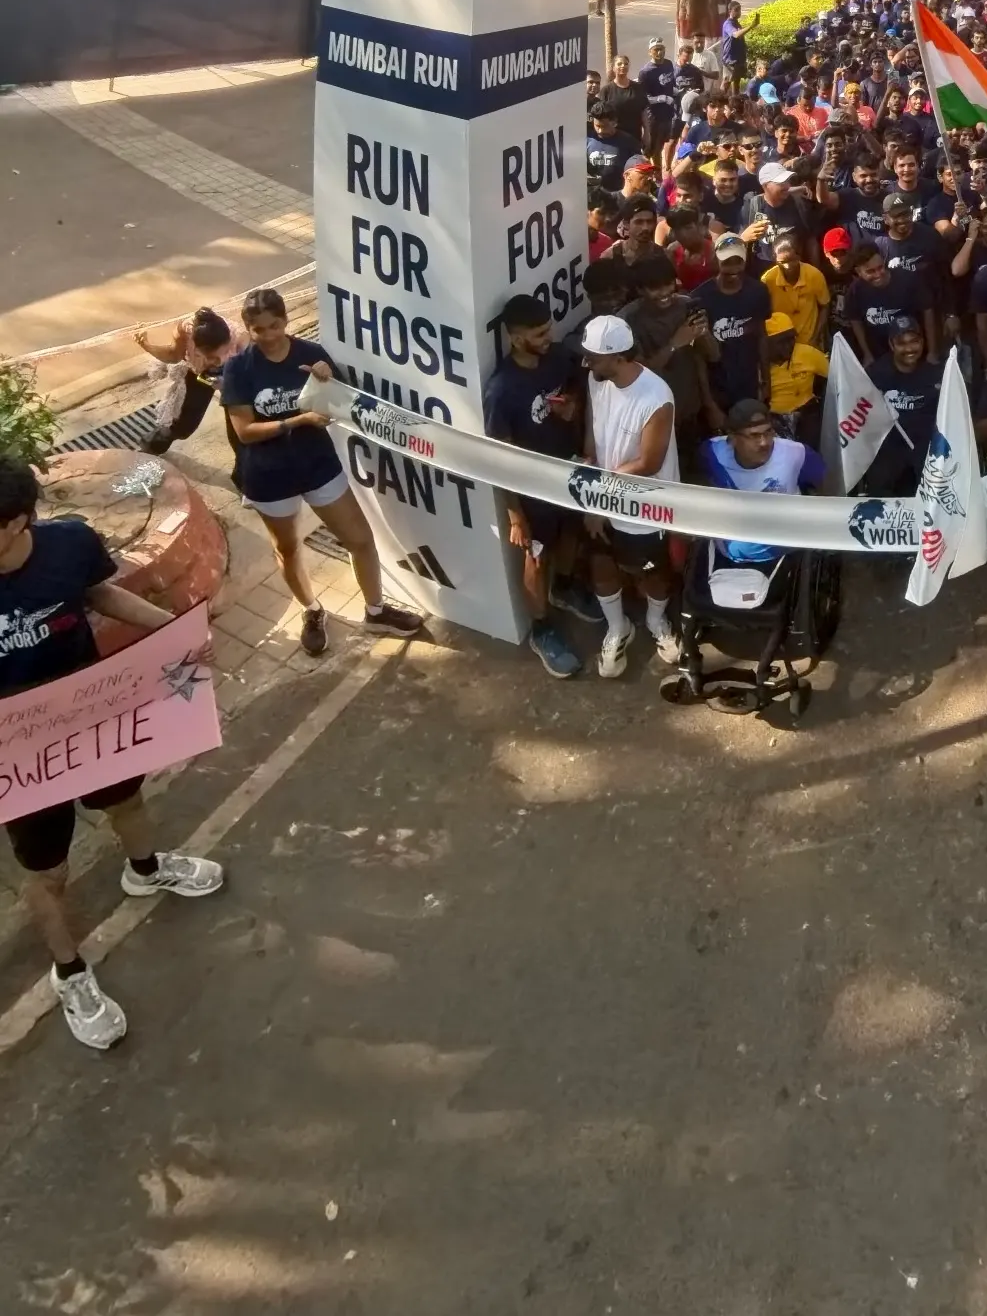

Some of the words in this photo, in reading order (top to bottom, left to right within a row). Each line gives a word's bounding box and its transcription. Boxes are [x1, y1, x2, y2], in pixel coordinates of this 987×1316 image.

[328, 31, 407, 81] MUMBAI
[414, 52, 459, 92] RUN
[481, 44, 549, 91] MUMBAI
[554, 37, 581, 69] RUN
[347, 133, 430, 218] RUN
[502, 125, 564, 208] RUN
[352, 215, 431, 299] FOR
[507, 200, 565, 284] FOR
[327, 283, 468, 388] THOSE
[721, 326, 744, 340] WORLD
[266, 397, 298, 415] WORLD
[376, 405, 408, 424] WINGS
[838, 396, 874, 440] RUN
[364, 418, 407, 447] WORLD
[408, 435, 435, 458] RUN
[347, 435, 476, 529] CAN'T
[602, 475, 640, 492] WINGS
[585, 490, 640, 517] WORLD
[641, 503, 674, 524] RUN
[890, 519, 914, 529] LIFE
[869, 529, 920, 546] WORL
[0, 623, 50, 651] WORLD
